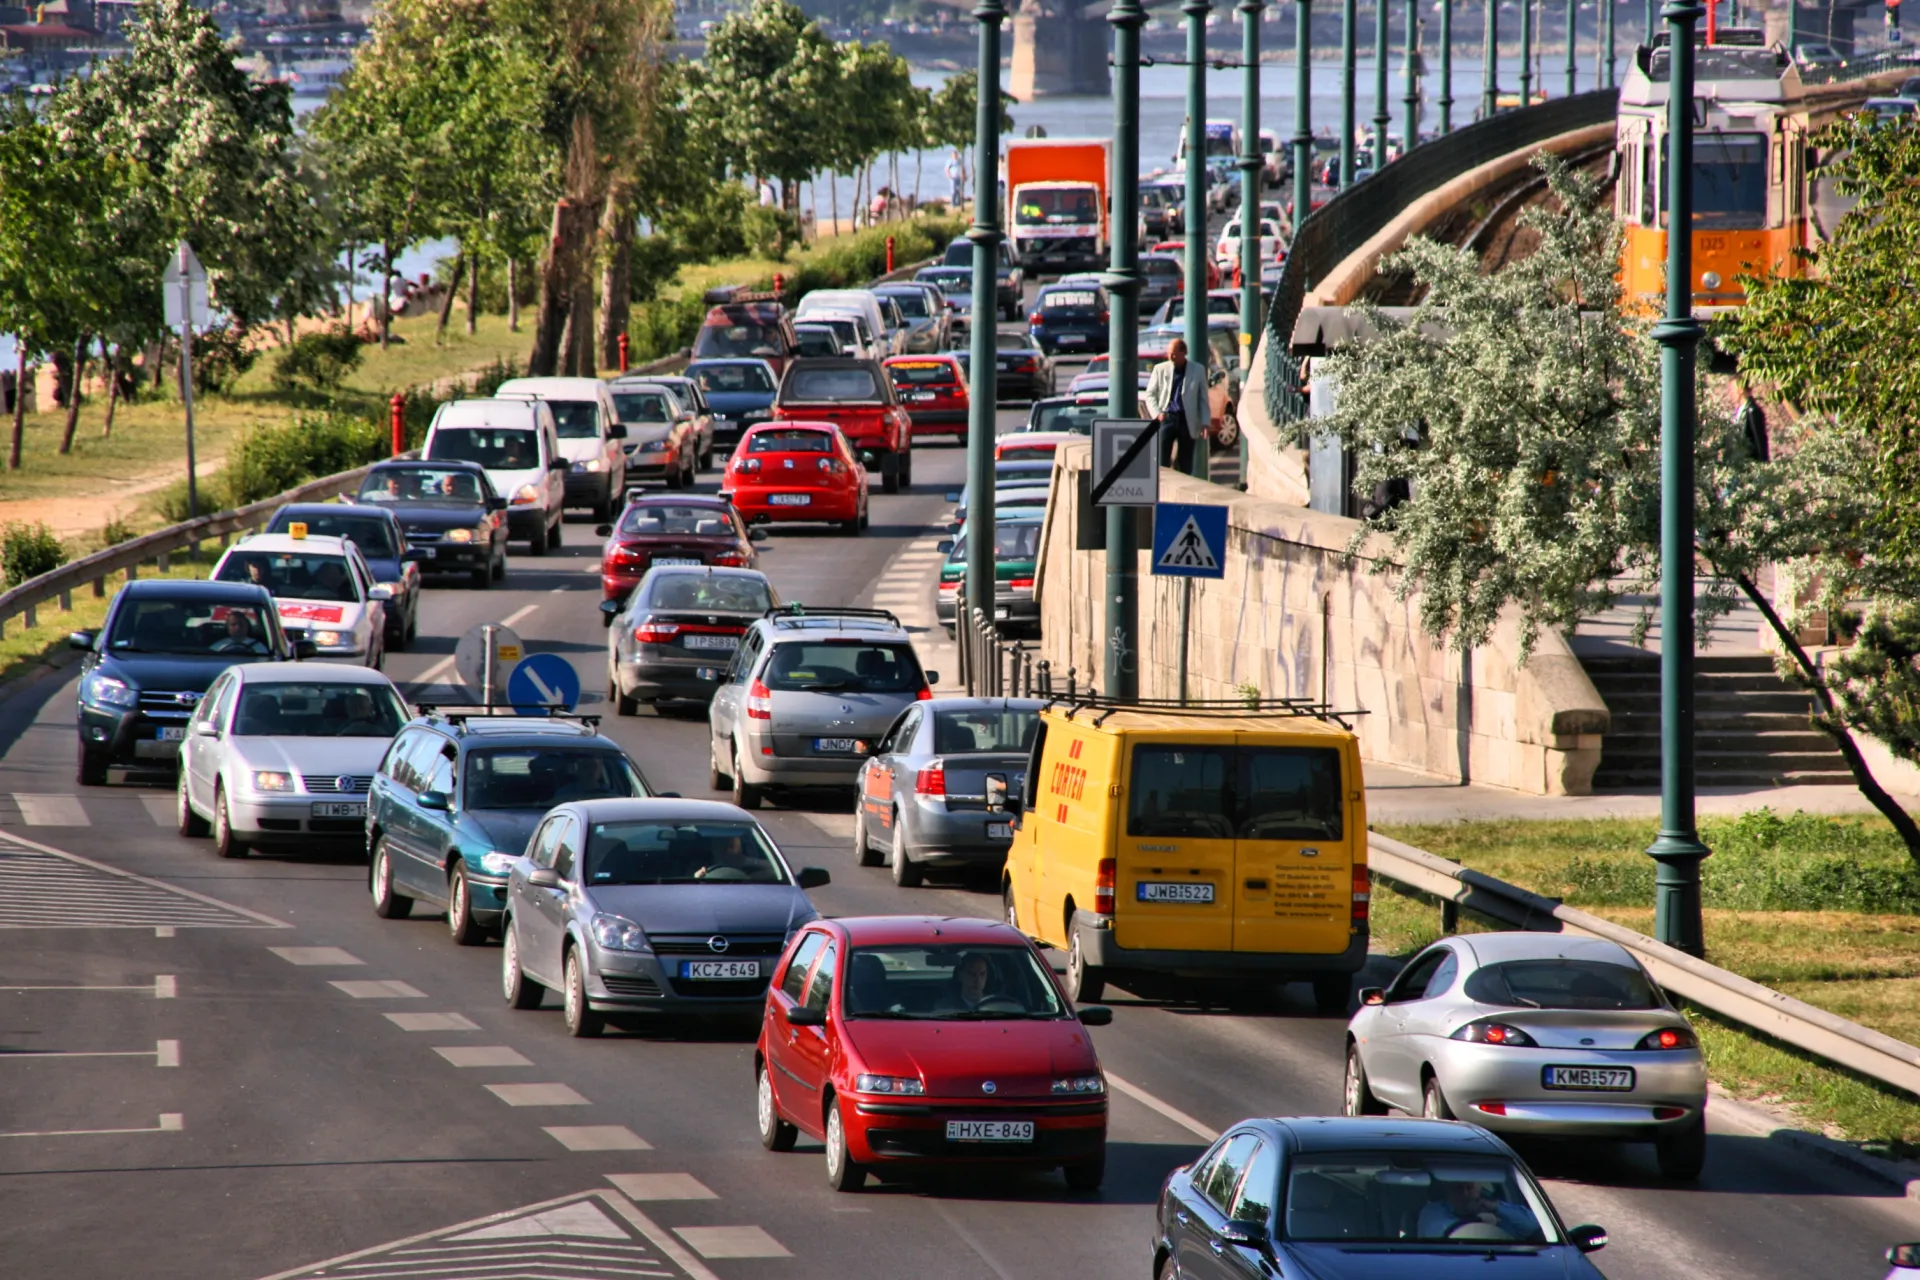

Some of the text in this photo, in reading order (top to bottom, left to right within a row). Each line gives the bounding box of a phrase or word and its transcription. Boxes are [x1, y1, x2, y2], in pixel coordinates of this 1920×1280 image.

[1051, 762, 1087, 801] CORTEN
[692, 963, 756, 977] KCZ-649
[960, 1122, 1032, 1138] HXE-849
